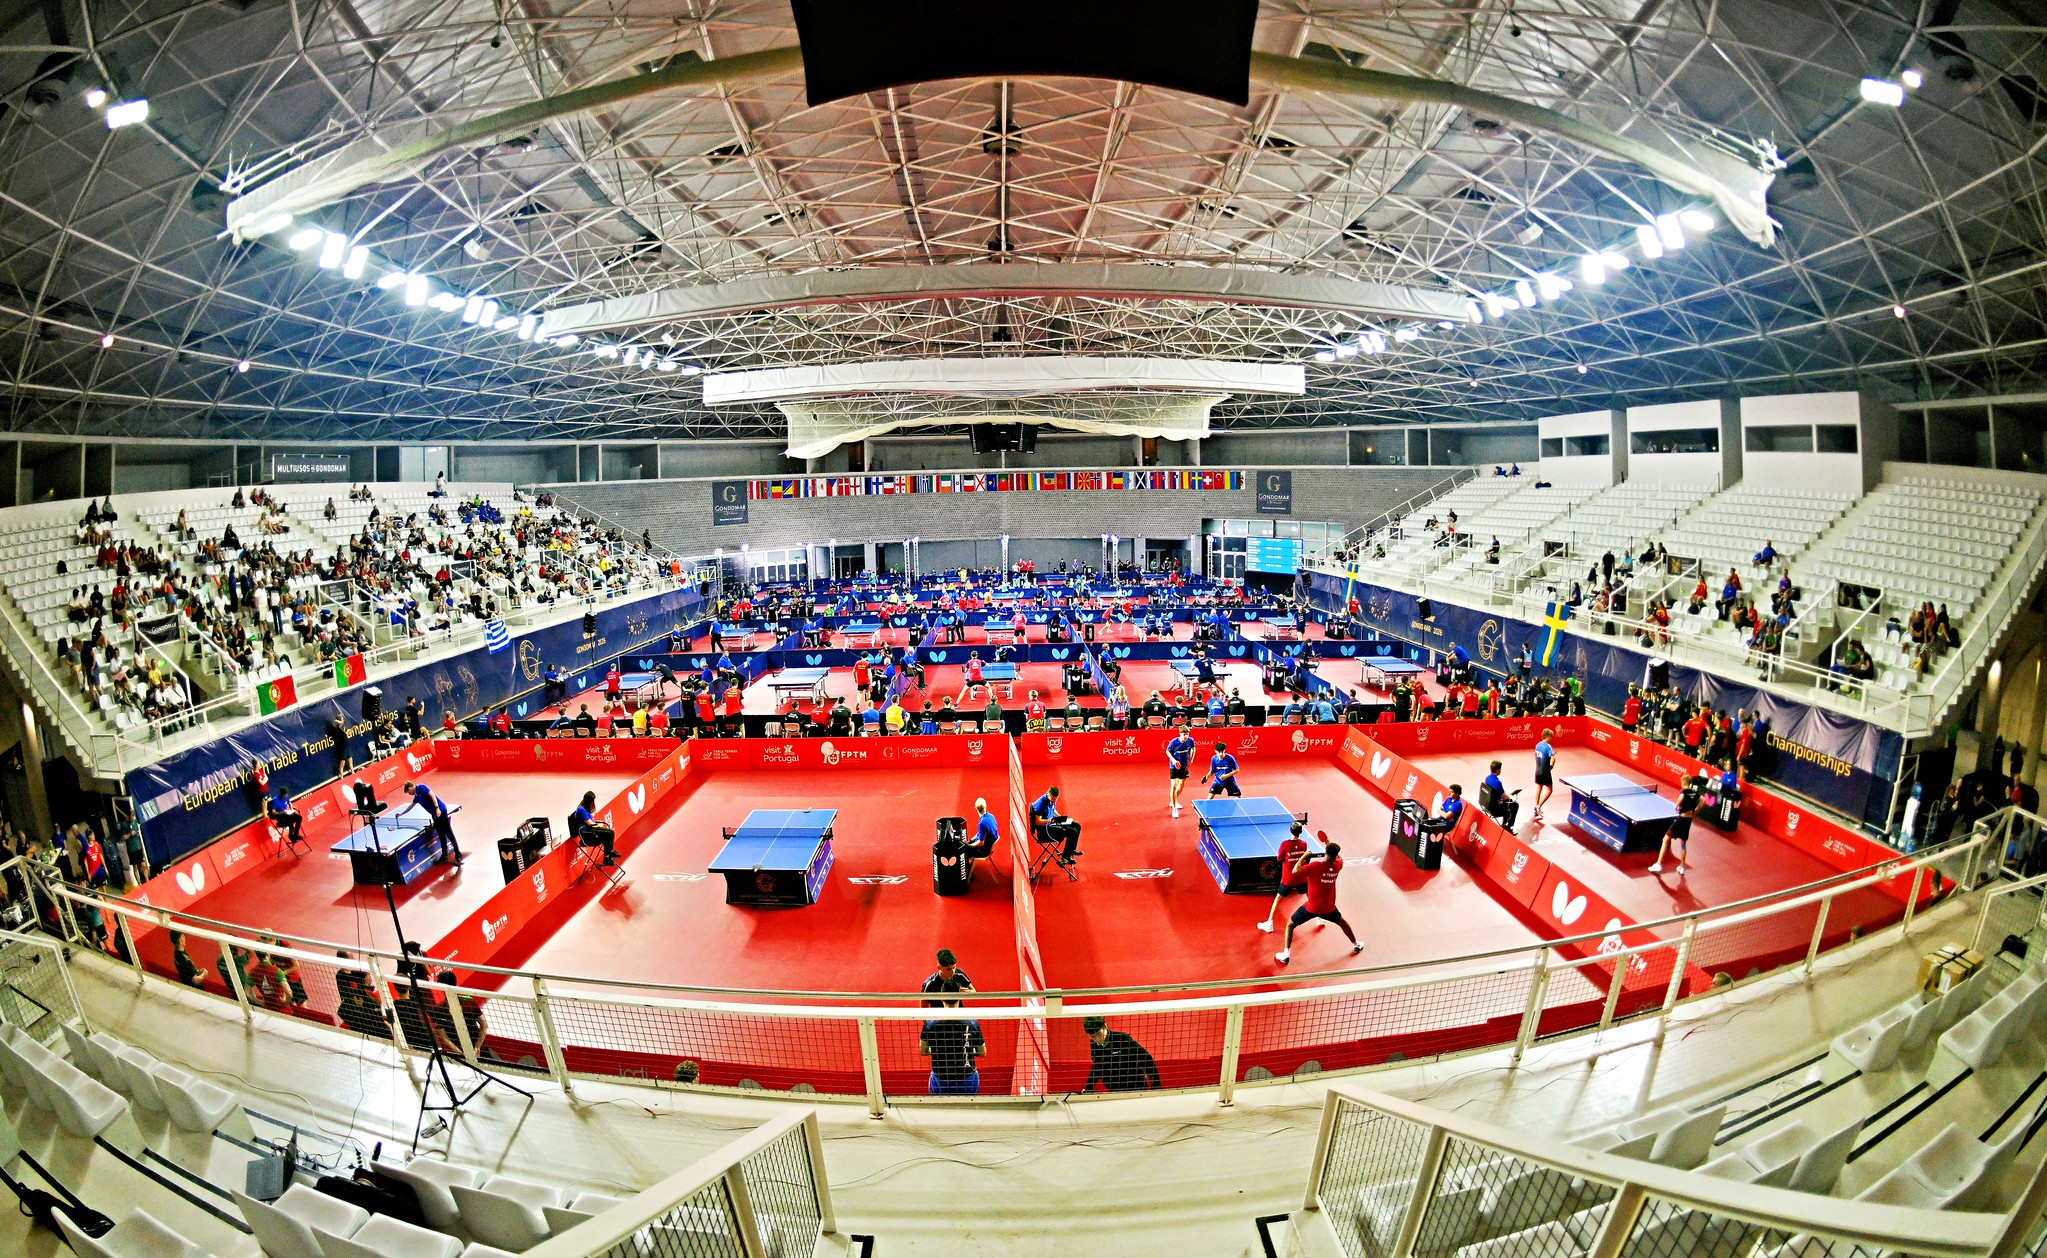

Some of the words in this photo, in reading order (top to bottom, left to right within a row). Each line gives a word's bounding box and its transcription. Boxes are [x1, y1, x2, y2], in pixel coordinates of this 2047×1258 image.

[277, 464, 310, 473] MULTIUSOS
[315, 464, 346, 472] GONDOMAR
[1266, 475, 1280, 491] G
[722, 485, 737, 502] G
[1509, 724, 1522, 732] visit
[1104, 738, 1123, 746] visit
[1309, 738, 1333, 746] FPTM
[585, 745, 601, 753] visit
[764, 745, 781, 754] visit
[882, 747, 894, 758] G
[1102, 747, 1141, 756] Portugal
[1765, 730, 1852, 777] Championships
[585, 754, 617, 763] Portugal
[763, 754, 800, 764] Portugal
[841, 750, 867, 759] FPTM
[183, 777, 239, 812] European
[237, 761, 270, 785] Yoh
[269, 750, 298, 771] Table
[302, 735, 335, 757] Tennis
